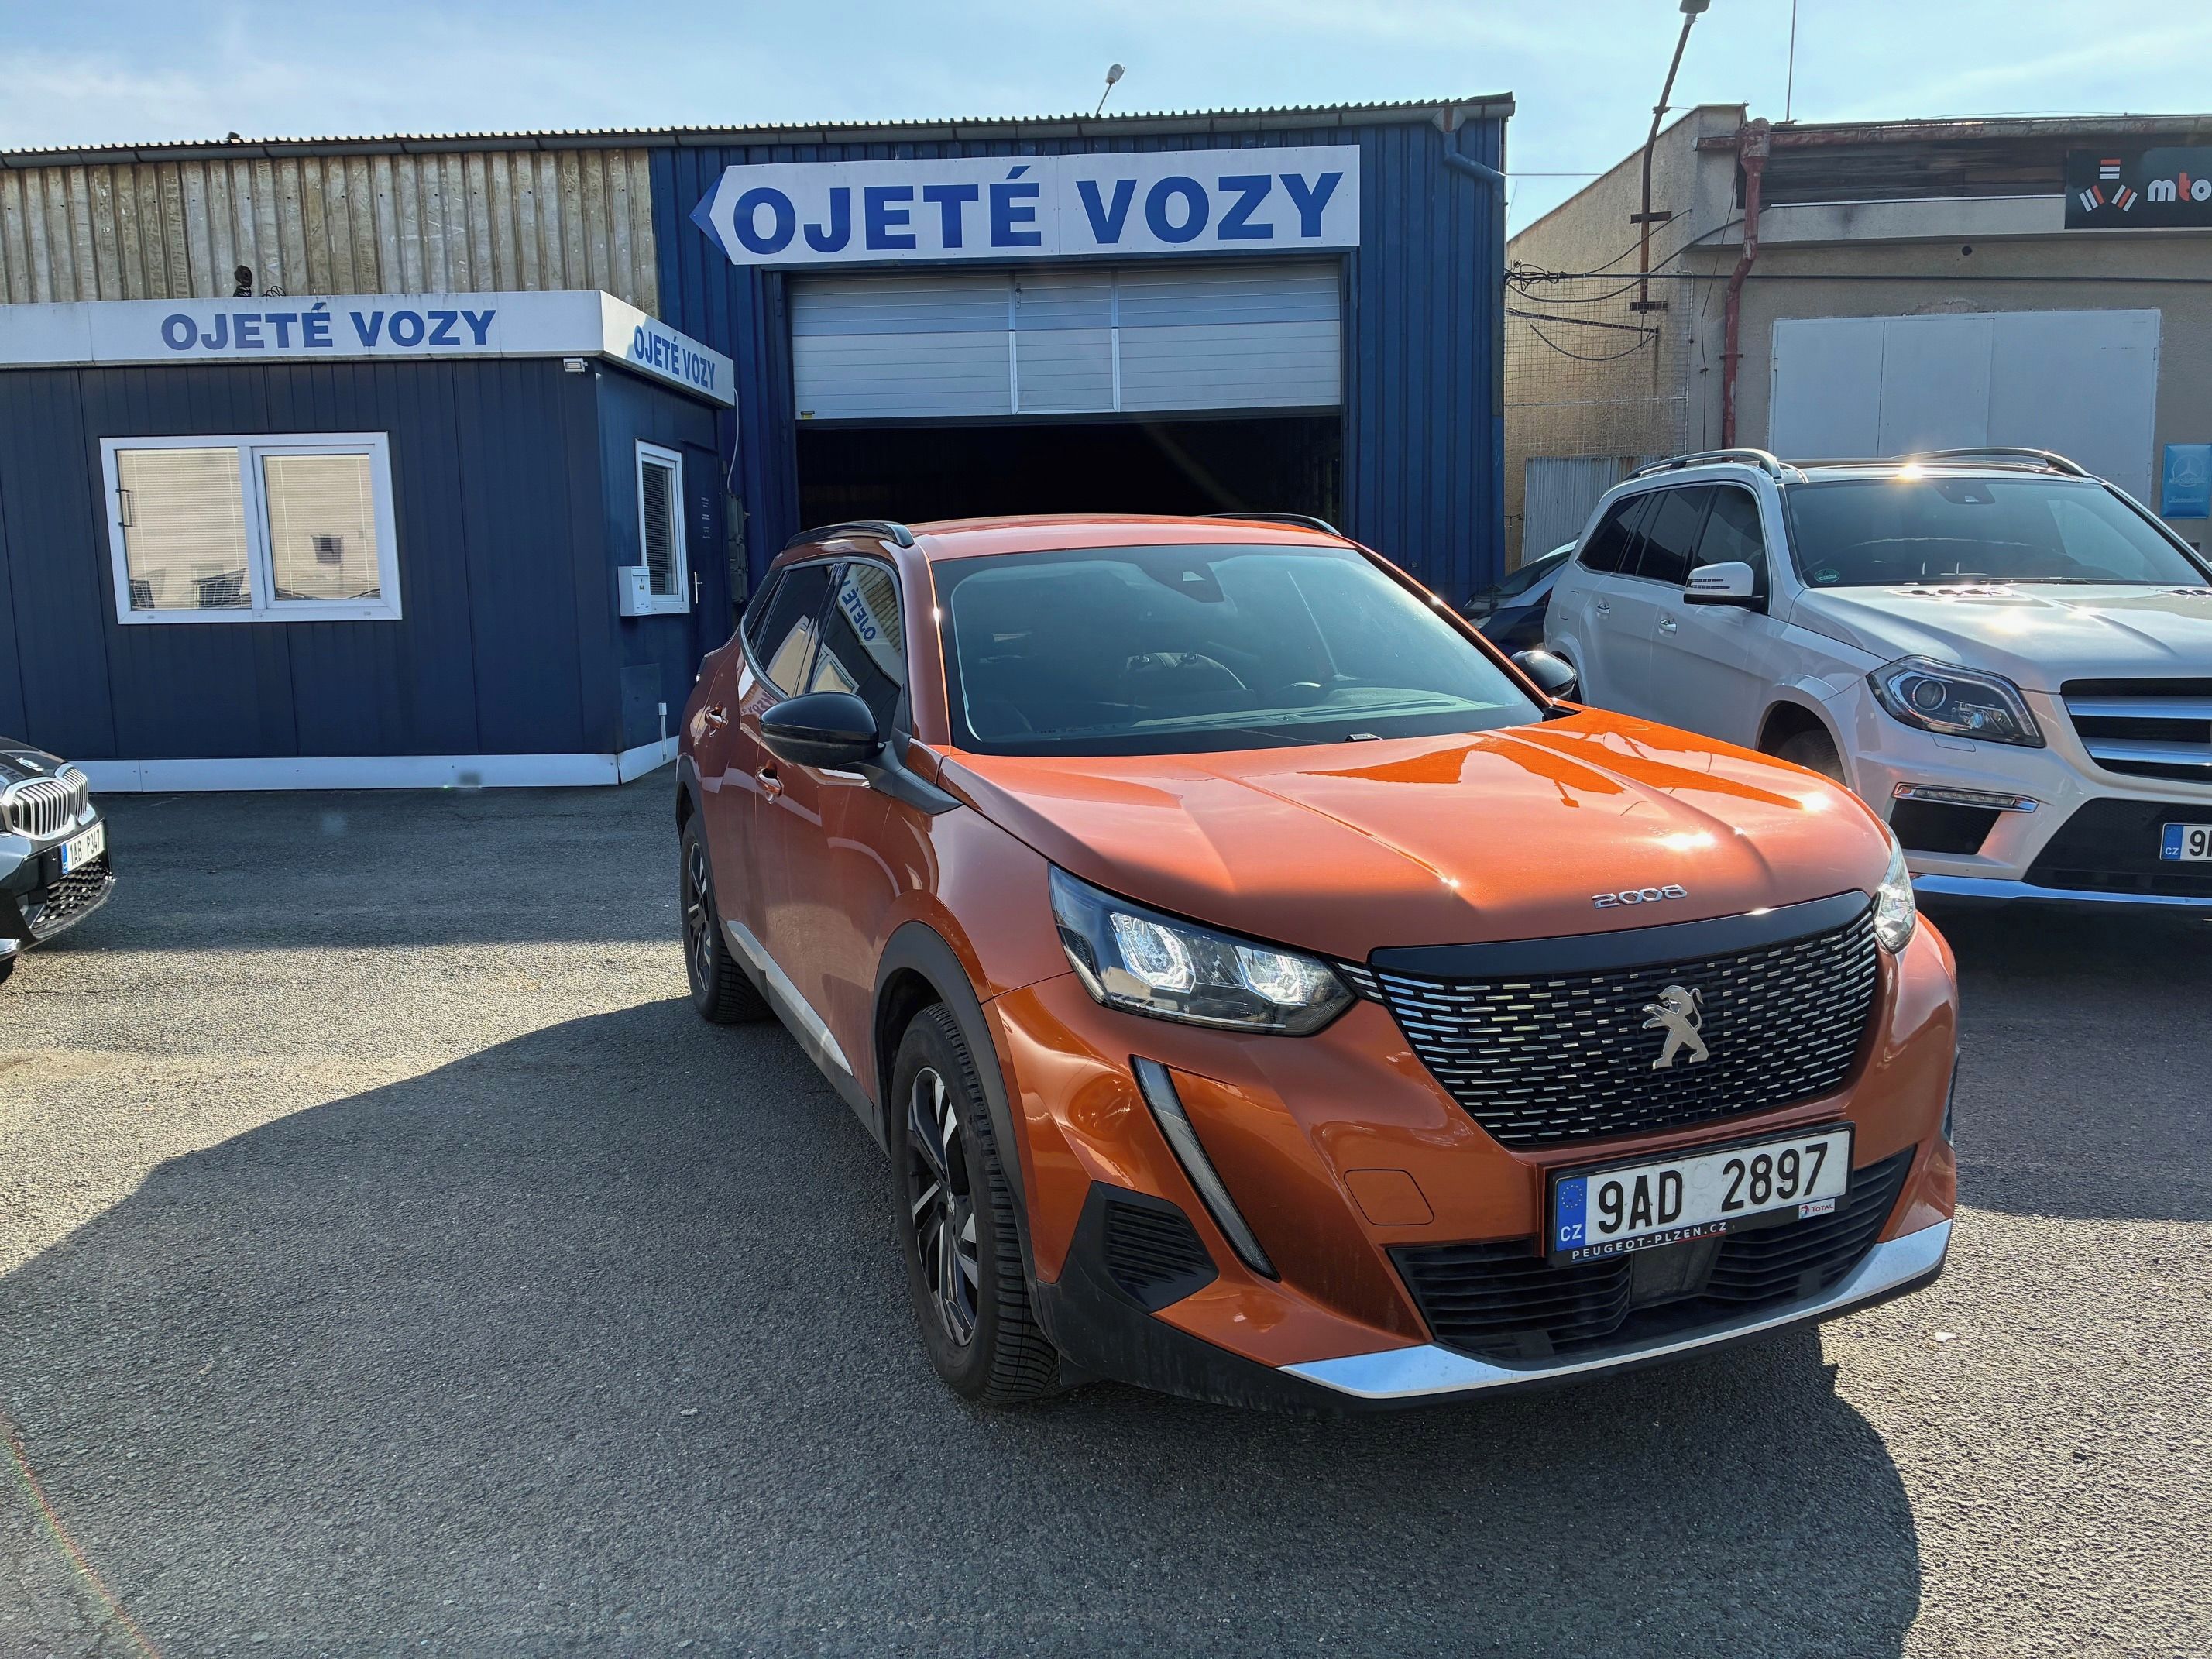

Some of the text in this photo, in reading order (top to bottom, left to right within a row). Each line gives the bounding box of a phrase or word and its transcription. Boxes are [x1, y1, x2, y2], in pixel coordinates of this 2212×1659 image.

[733, 165, 1344, 255] OJETÉ VOZY
[161, 302, 497, 351] OJETÉ VOZY
[634, 325, 715, 390] OJETÉ VOZY
[2165, 847, 2179, 855] CZ
[2189, 830, 2212, 857] 9
[1592, 884, 1688, 909] 2008
[1598, 1142, 1829, 1234] 9AD 2897
[1560, 1224, 1582, 1242] CZ
[1571, 1221, 1727, 1260] PEUGEOT-PLZEN.CZ
